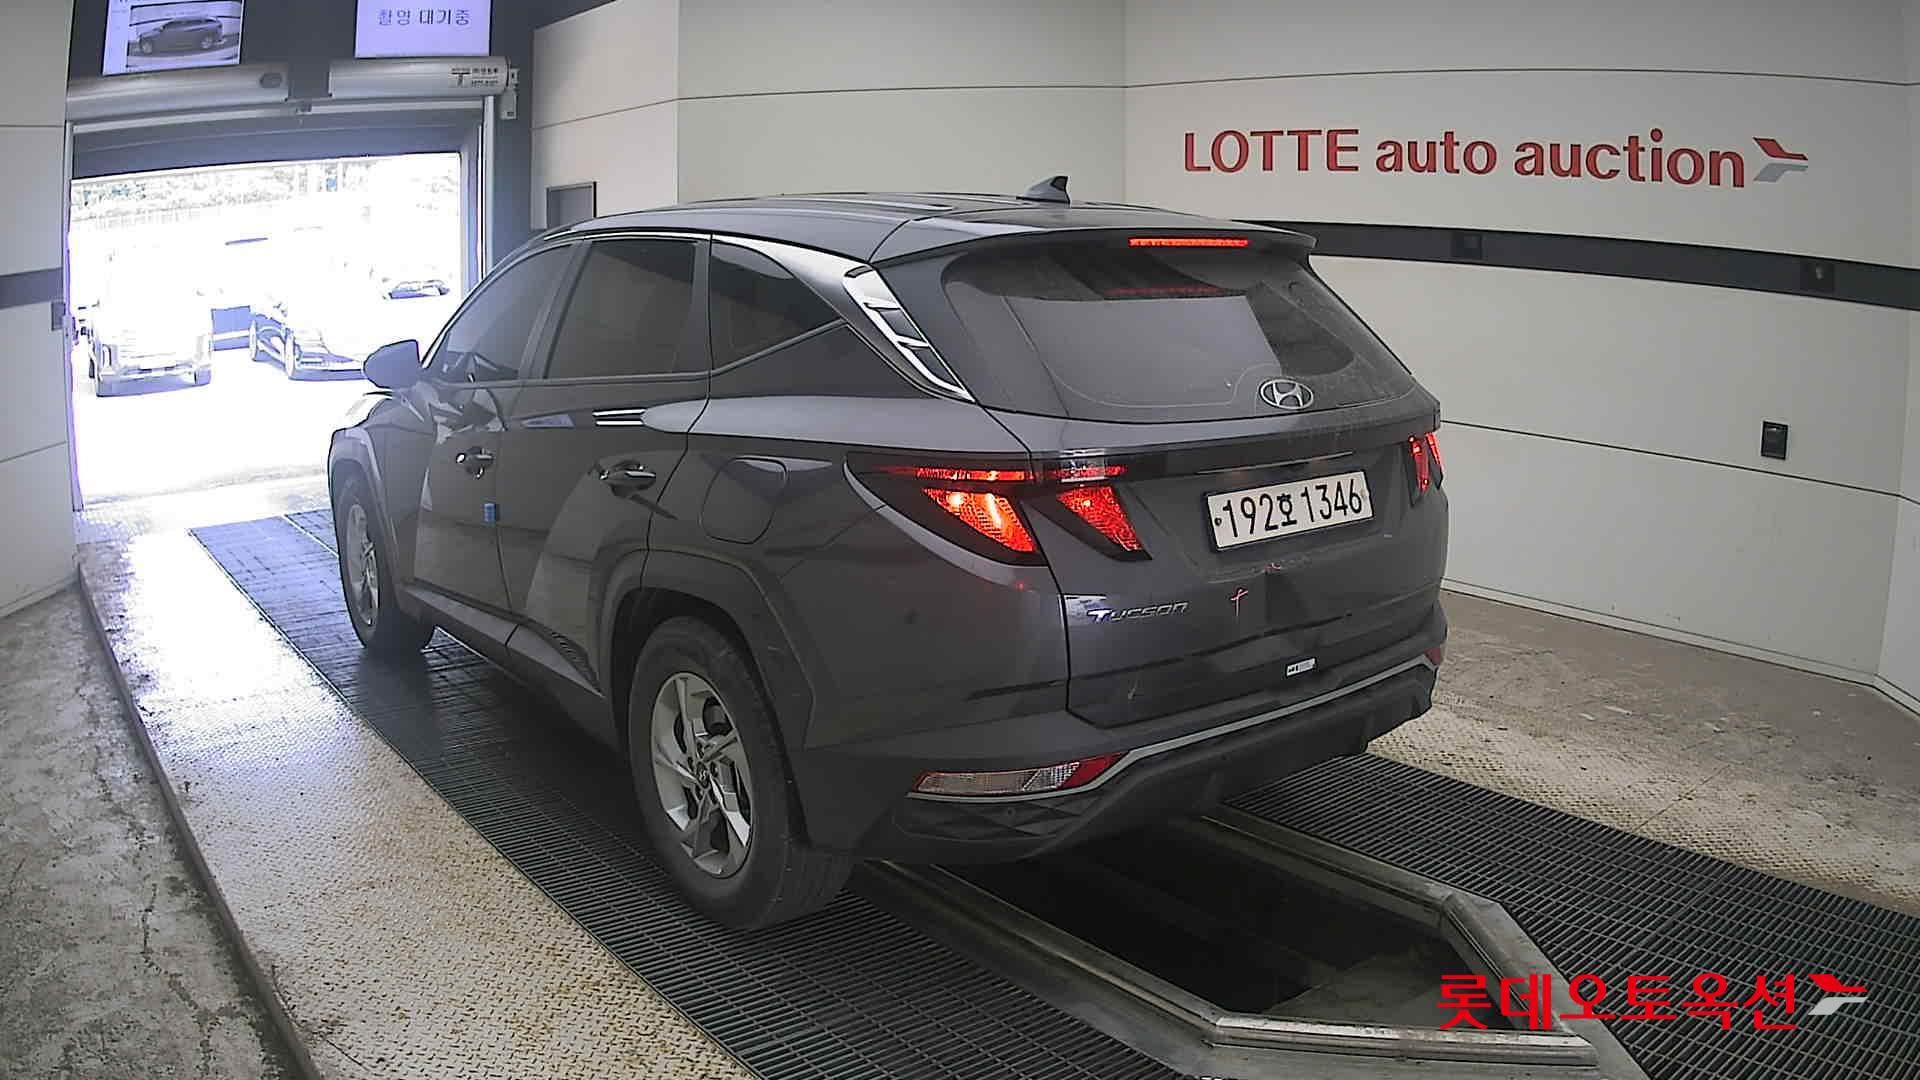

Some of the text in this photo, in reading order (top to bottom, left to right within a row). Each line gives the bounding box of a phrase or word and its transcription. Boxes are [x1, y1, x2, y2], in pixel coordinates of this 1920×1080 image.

[419, 9, 470, 26] 대기중
[1184, 128, 1745, 187] LOTTE auto auction
